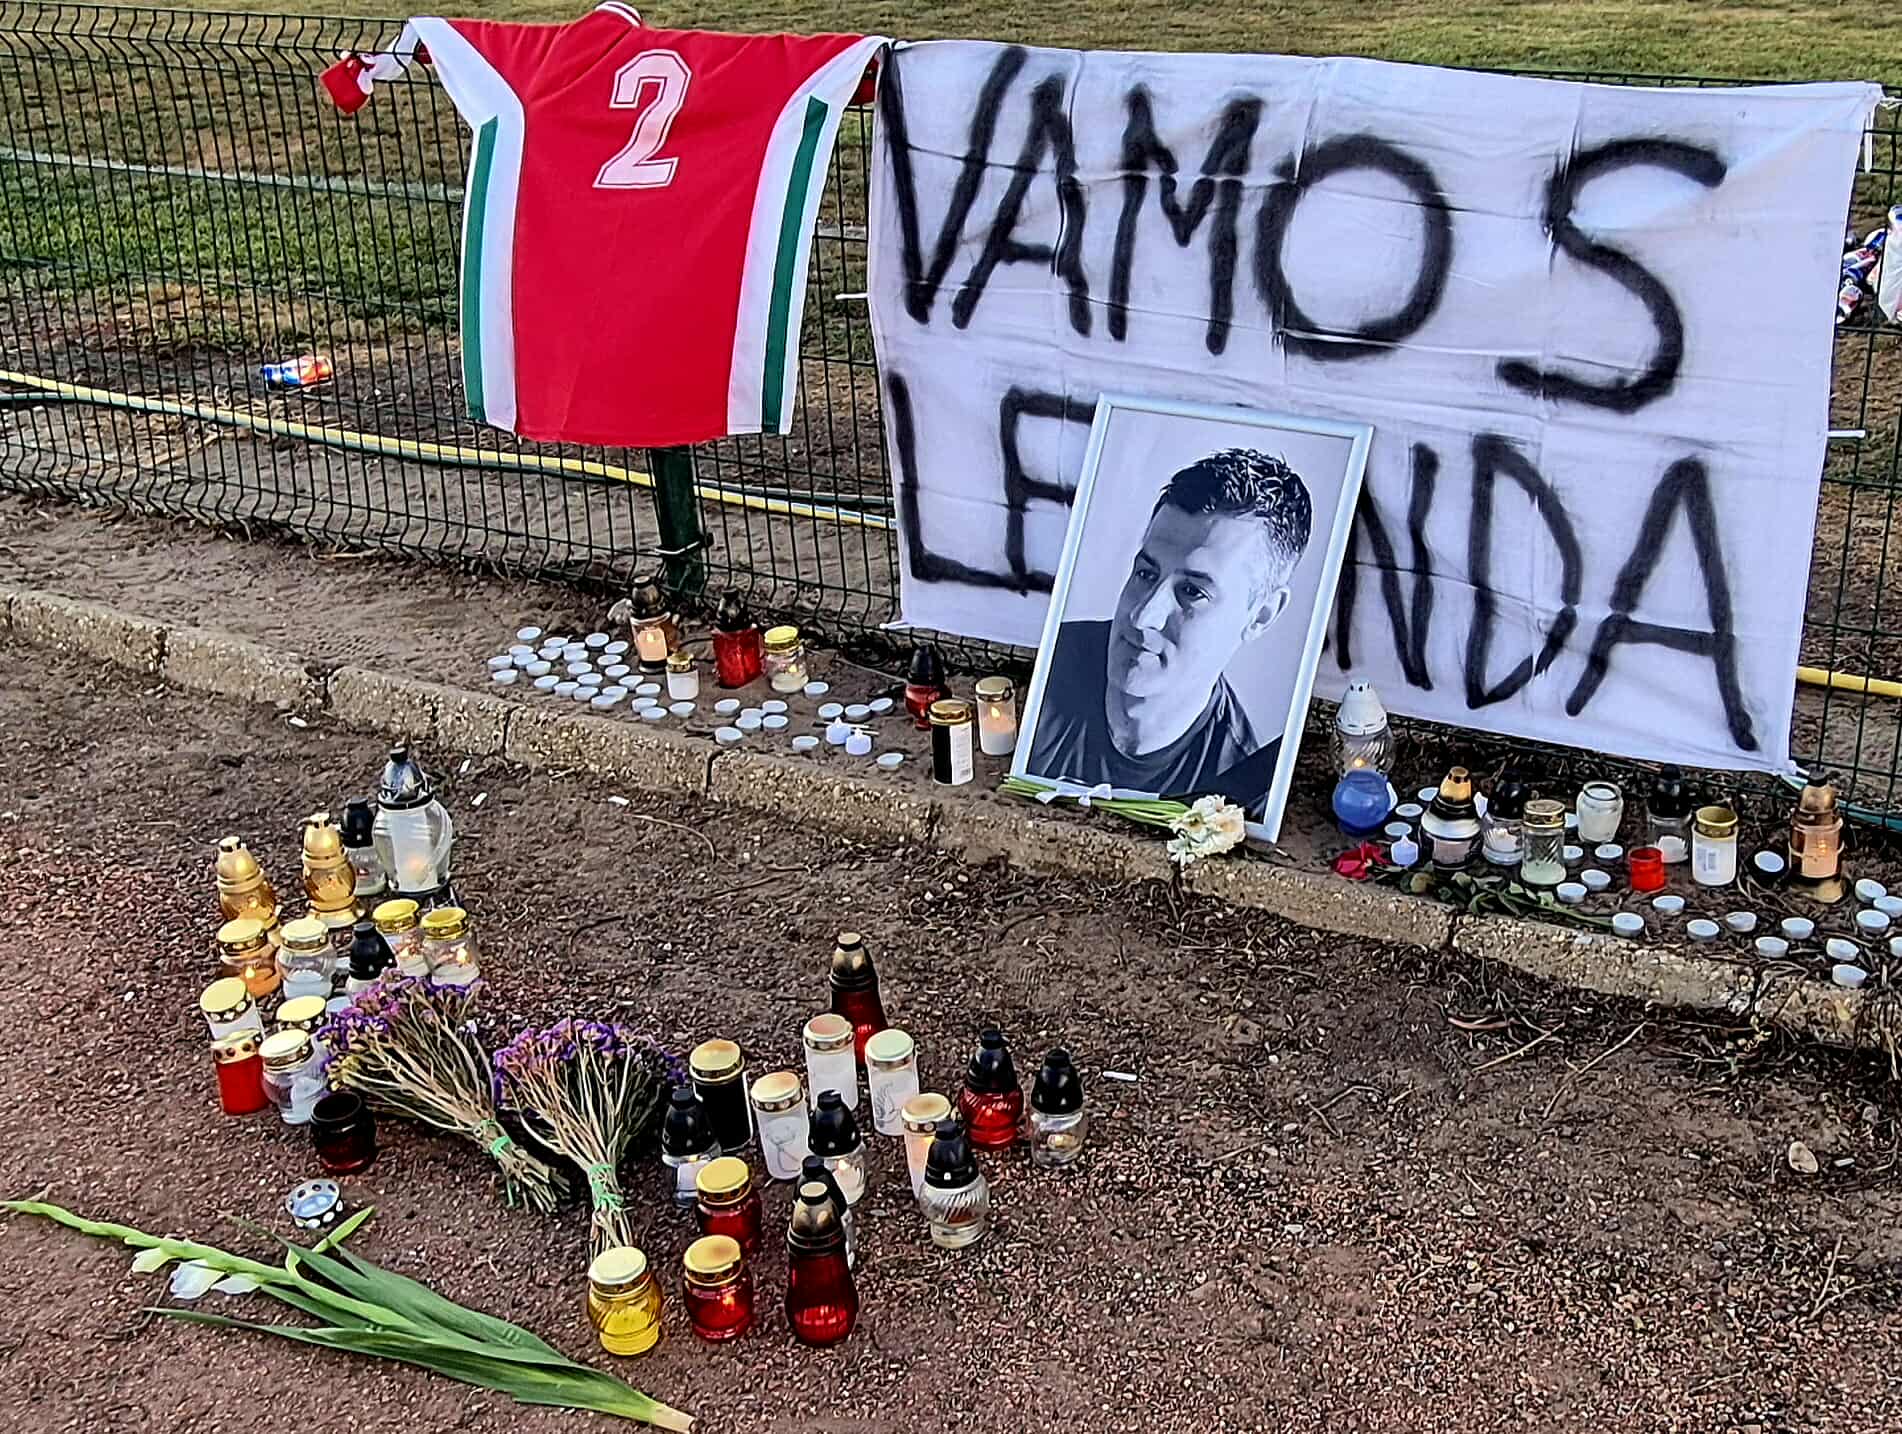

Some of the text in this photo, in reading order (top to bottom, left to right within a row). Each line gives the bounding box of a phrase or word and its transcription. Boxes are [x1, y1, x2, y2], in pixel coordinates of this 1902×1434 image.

[592, 49, 692, 189] 2
[879, 47, 1727, 412] VAMOS
[888, 372, 1758, 751] LENDA
